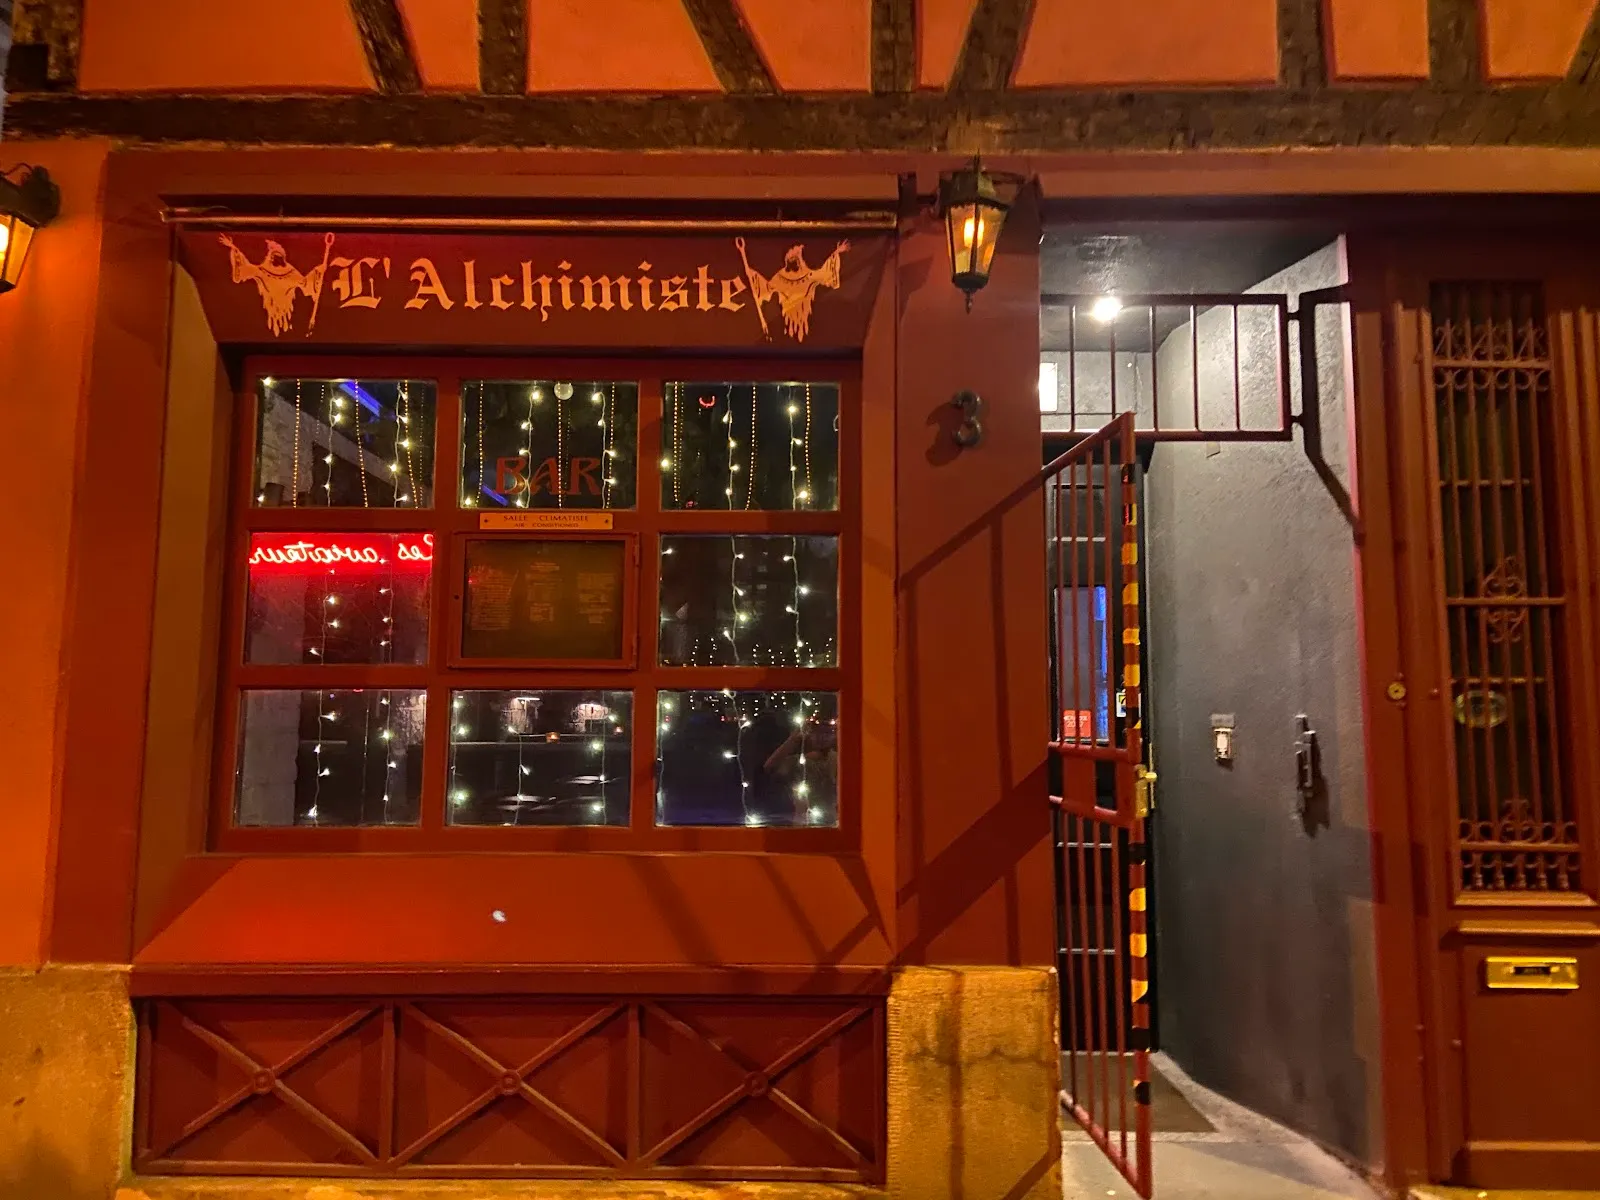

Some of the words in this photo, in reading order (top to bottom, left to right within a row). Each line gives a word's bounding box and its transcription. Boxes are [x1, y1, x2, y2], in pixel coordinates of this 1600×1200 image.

[329, 256, 391, 309] L'
[404, 257, 747, 322] Alchimiste
[494, 456, 602, 496] BAR
[503, 514, 528, 522] SALLE
